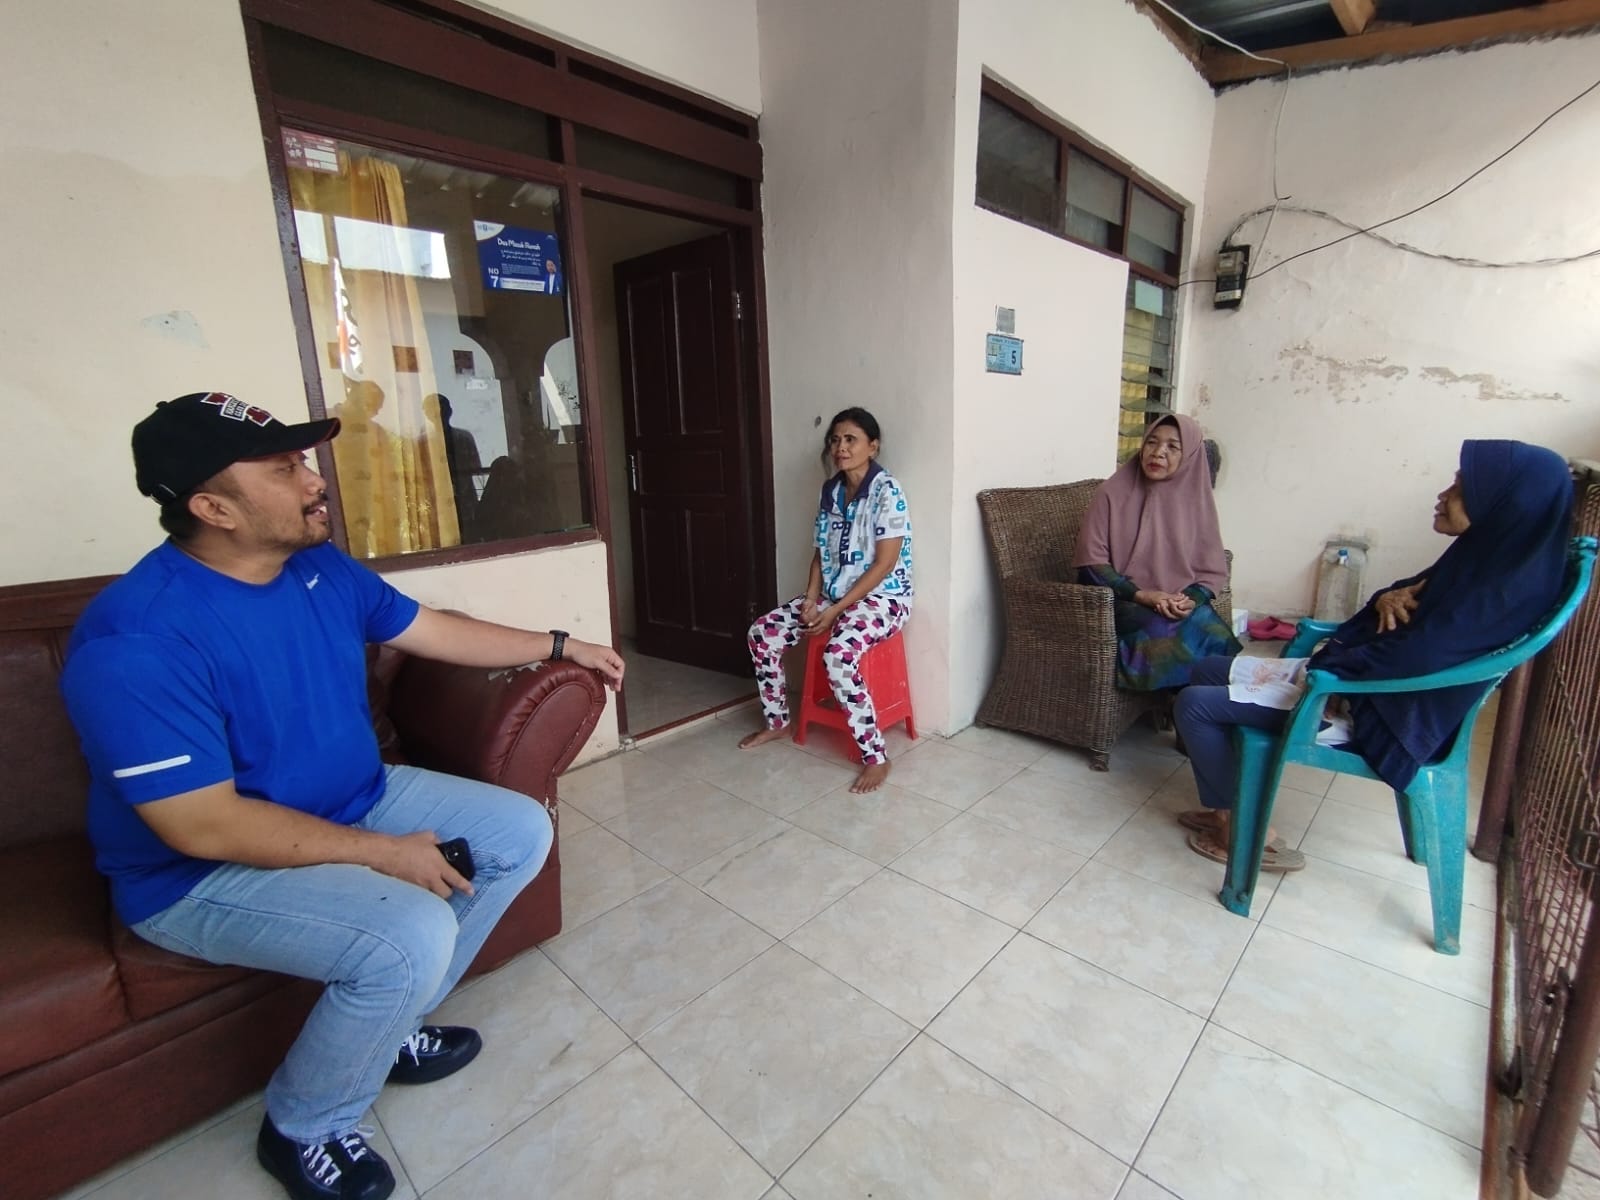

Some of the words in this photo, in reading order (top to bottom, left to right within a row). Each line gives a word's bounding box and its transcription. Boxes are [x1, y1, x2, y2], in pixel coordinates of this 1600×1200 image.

[488, 267, 499, 275] NO
[490, 275, 499, 287] 7
[1011, 350, 1017, 365] 5
